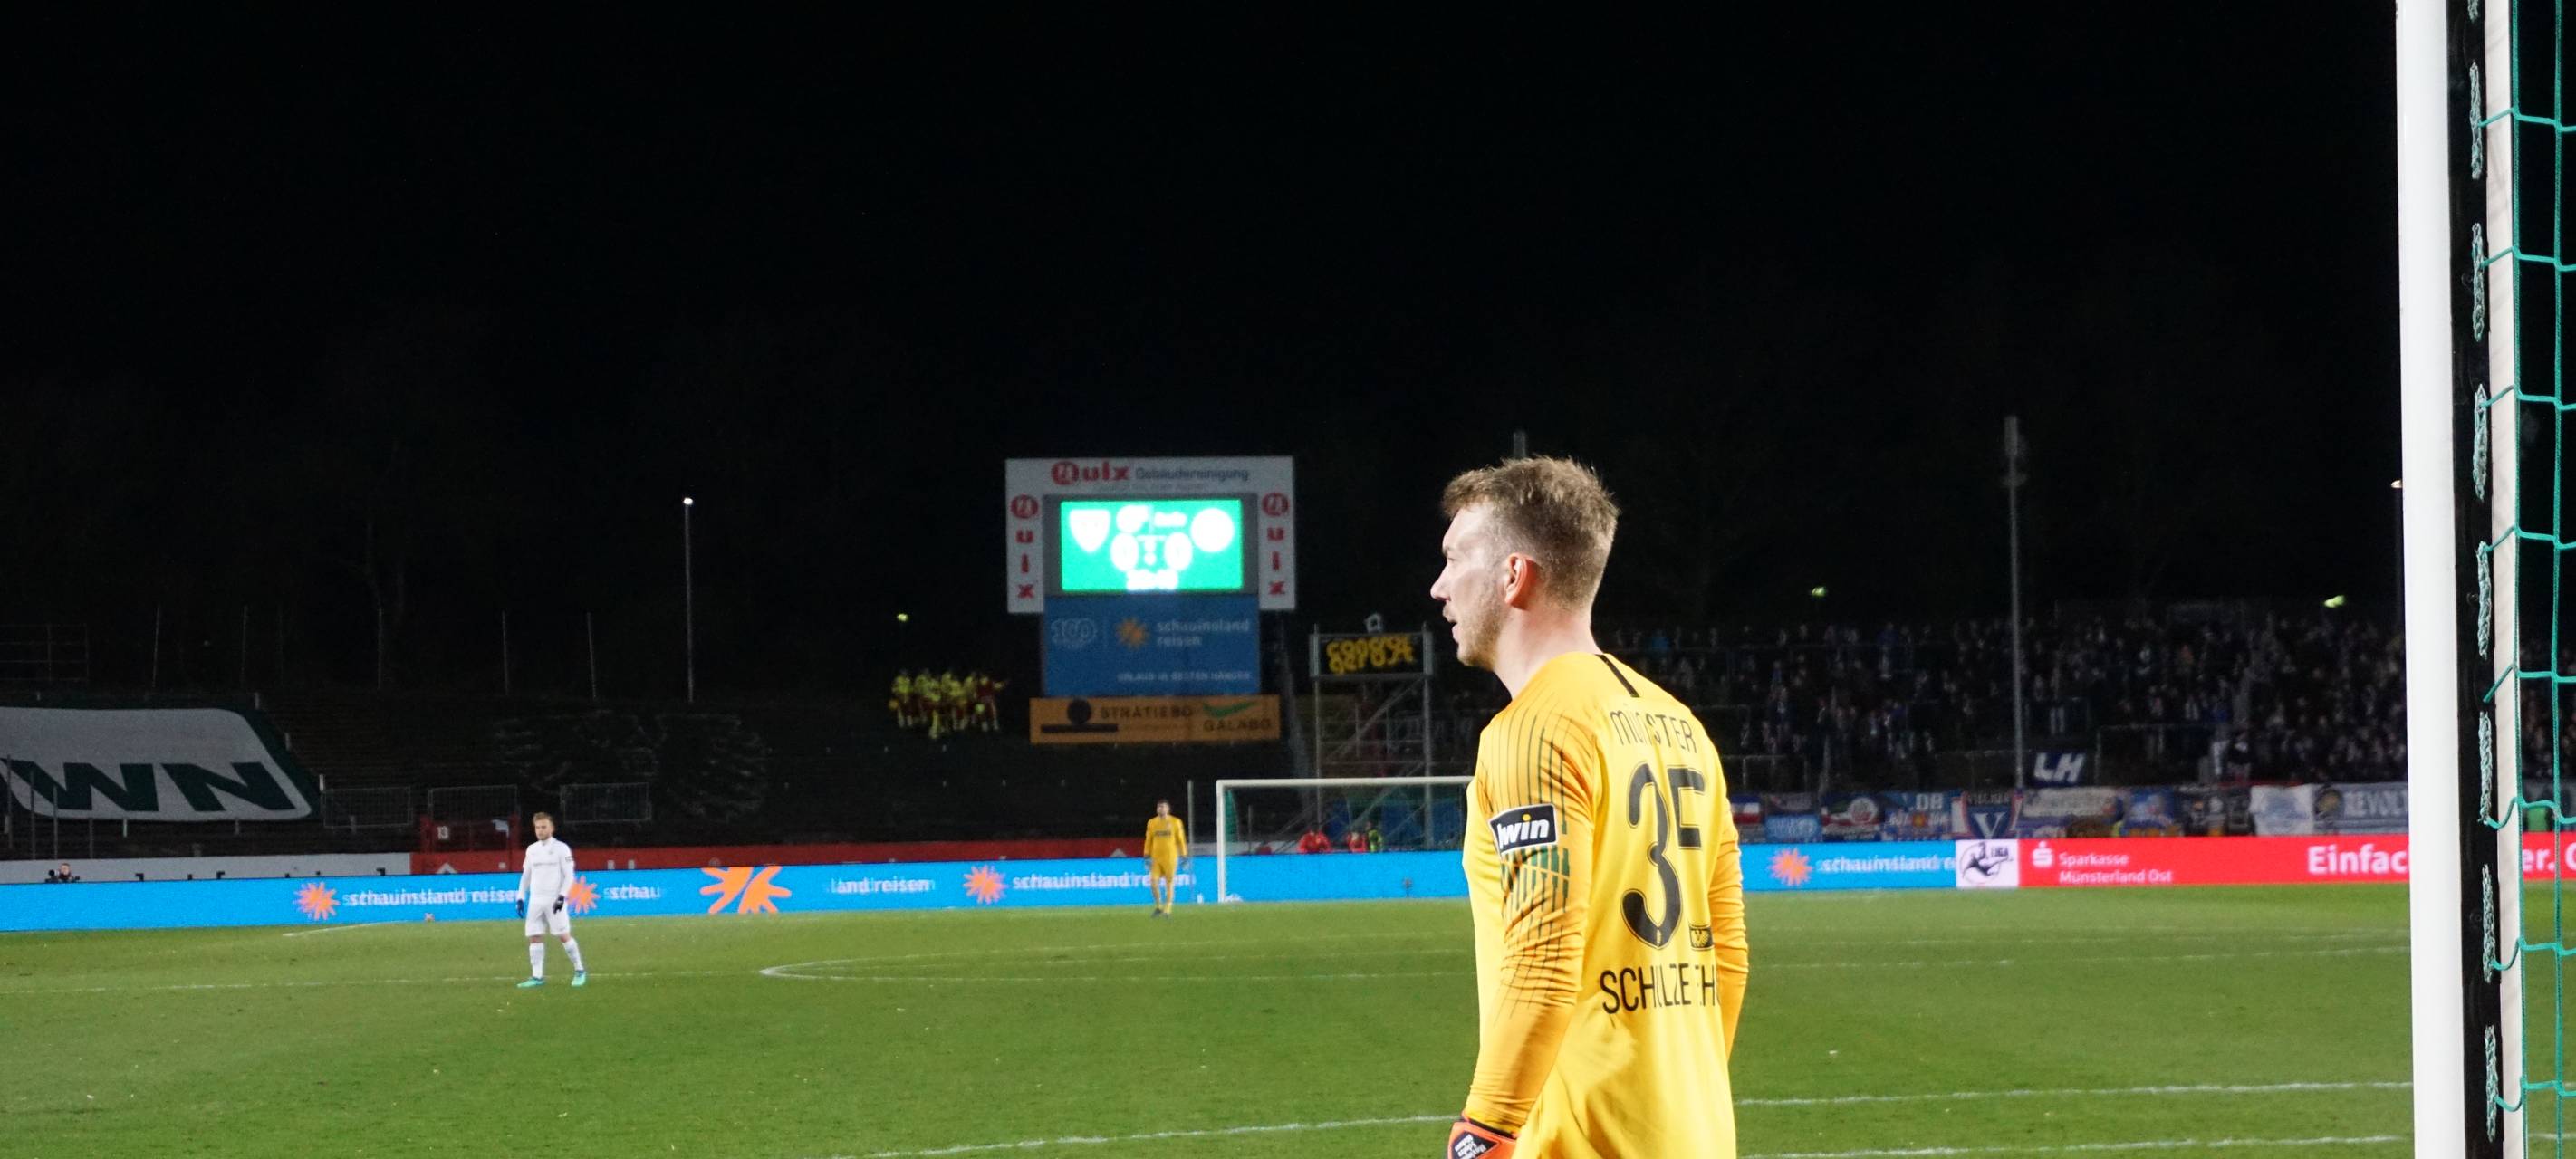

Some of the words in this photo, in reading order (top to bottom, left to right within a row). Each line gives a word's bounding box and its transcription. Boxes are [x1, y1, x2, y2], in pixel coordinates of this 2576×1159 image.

[2033, 752, 2082, 781] LH
[2058, 852, 2129, 867] Sparkasse
[2308, 843, 2408, 875] Einfac
[2059, 870, 2145, 884] Münsterland
[2148, 870, 2172, 884] Ost
